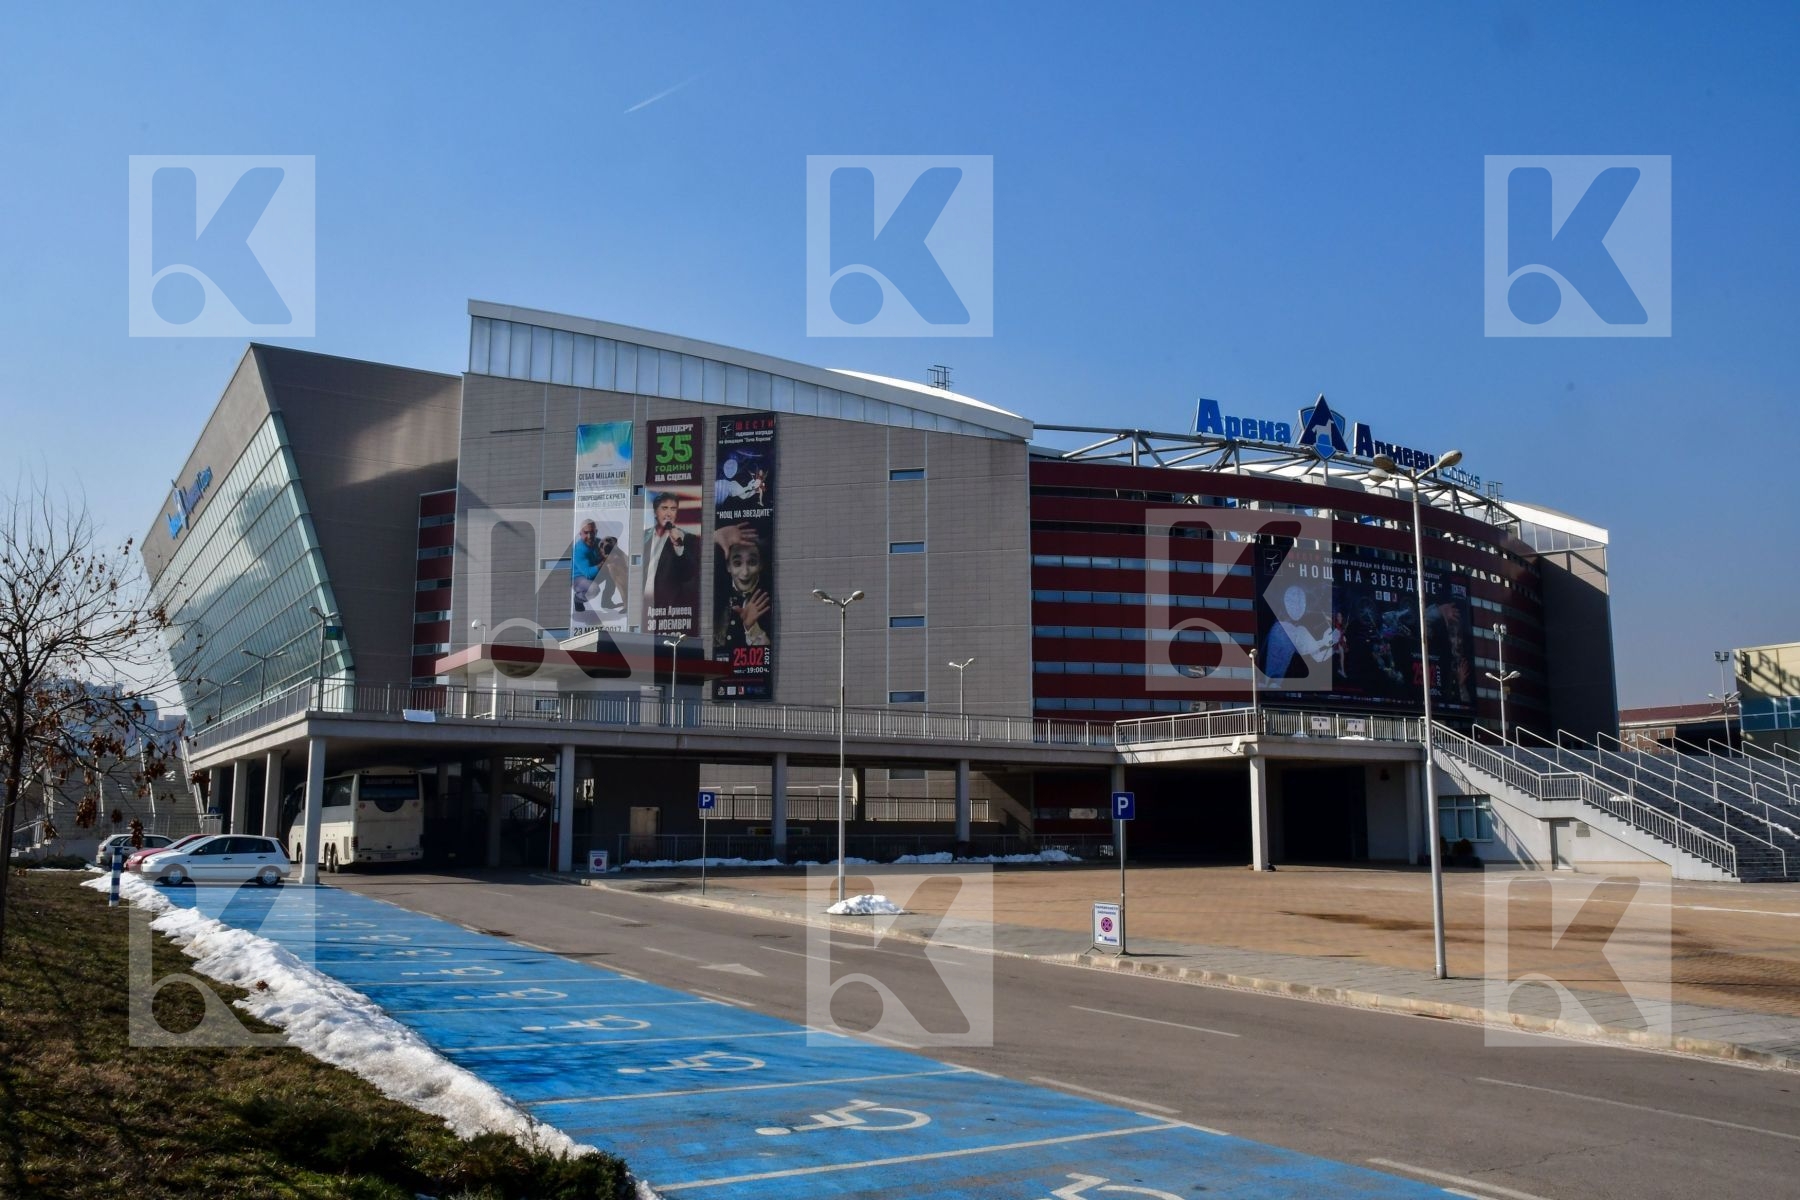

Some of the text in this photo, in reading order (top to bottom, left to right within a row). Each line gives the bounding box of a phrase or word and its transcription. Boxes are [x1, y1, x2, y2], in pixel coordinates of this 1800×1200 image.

[1195, 398, 1290, 443] Арена
[656, 423, 694, 434] КОНЦЕРТ
[655, 434, 693, 464] 35
[615, 470, 626, 479] LIVE
[655, 463, 693, 473] ГОДИНИ
[654, 472, 692, 482] НА СЦЕНА
[734, 510, 742, 518] НА
[1344, 569, 1362, 584] НА
[1371, 572, 1443, 595] ЗВЕЗДТЕ”
[648, 605, 693, 618] Арена Армеец
[647, 618, 692, 631] 30 НОЕМВРИ
[733, 647, 764, 667] 25.02
[702, 793, 711, 807] P
[1117, 796, 1129, 816] P
